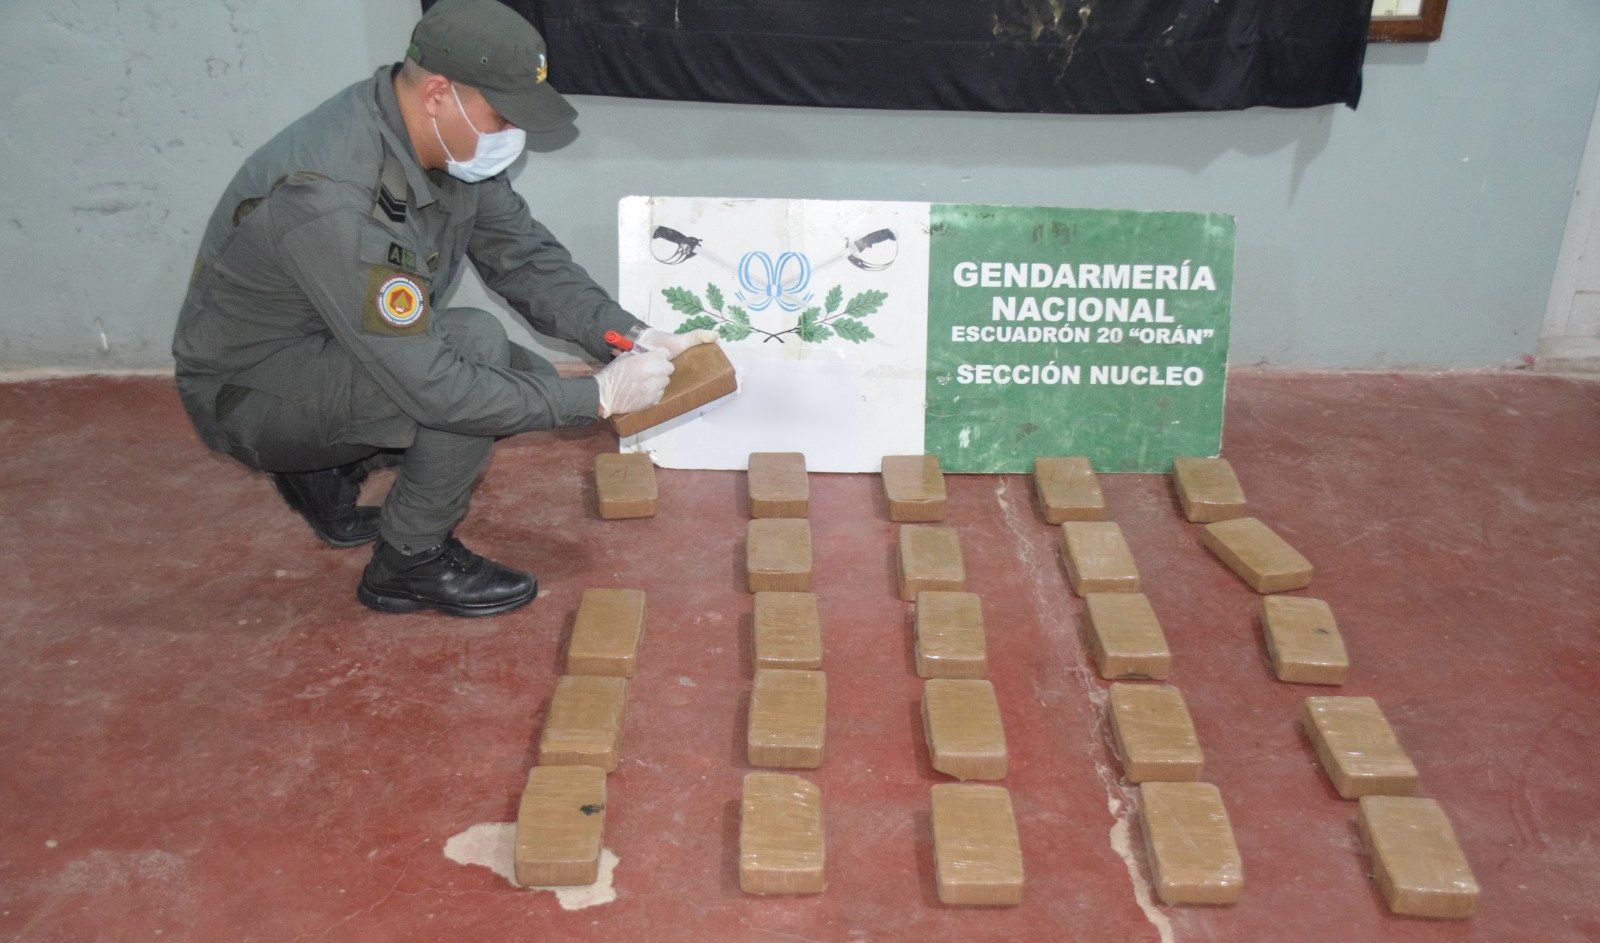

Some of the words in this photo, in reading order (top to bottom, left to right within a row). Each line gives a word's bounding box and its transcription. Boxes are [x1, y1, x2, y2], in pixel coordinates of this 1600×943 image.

[953, 260, 1216, 290] GENDARMERÍA
[991, 296, 1175, 323] NACIONAL
[951, 324, 1090, 343] ESCUADRÓN
[1096, 326, 1124, 344] 20
[956, 360, 1081, 385] SECCIÓN
[1089, 365, 1204, 386] NUCLEO
